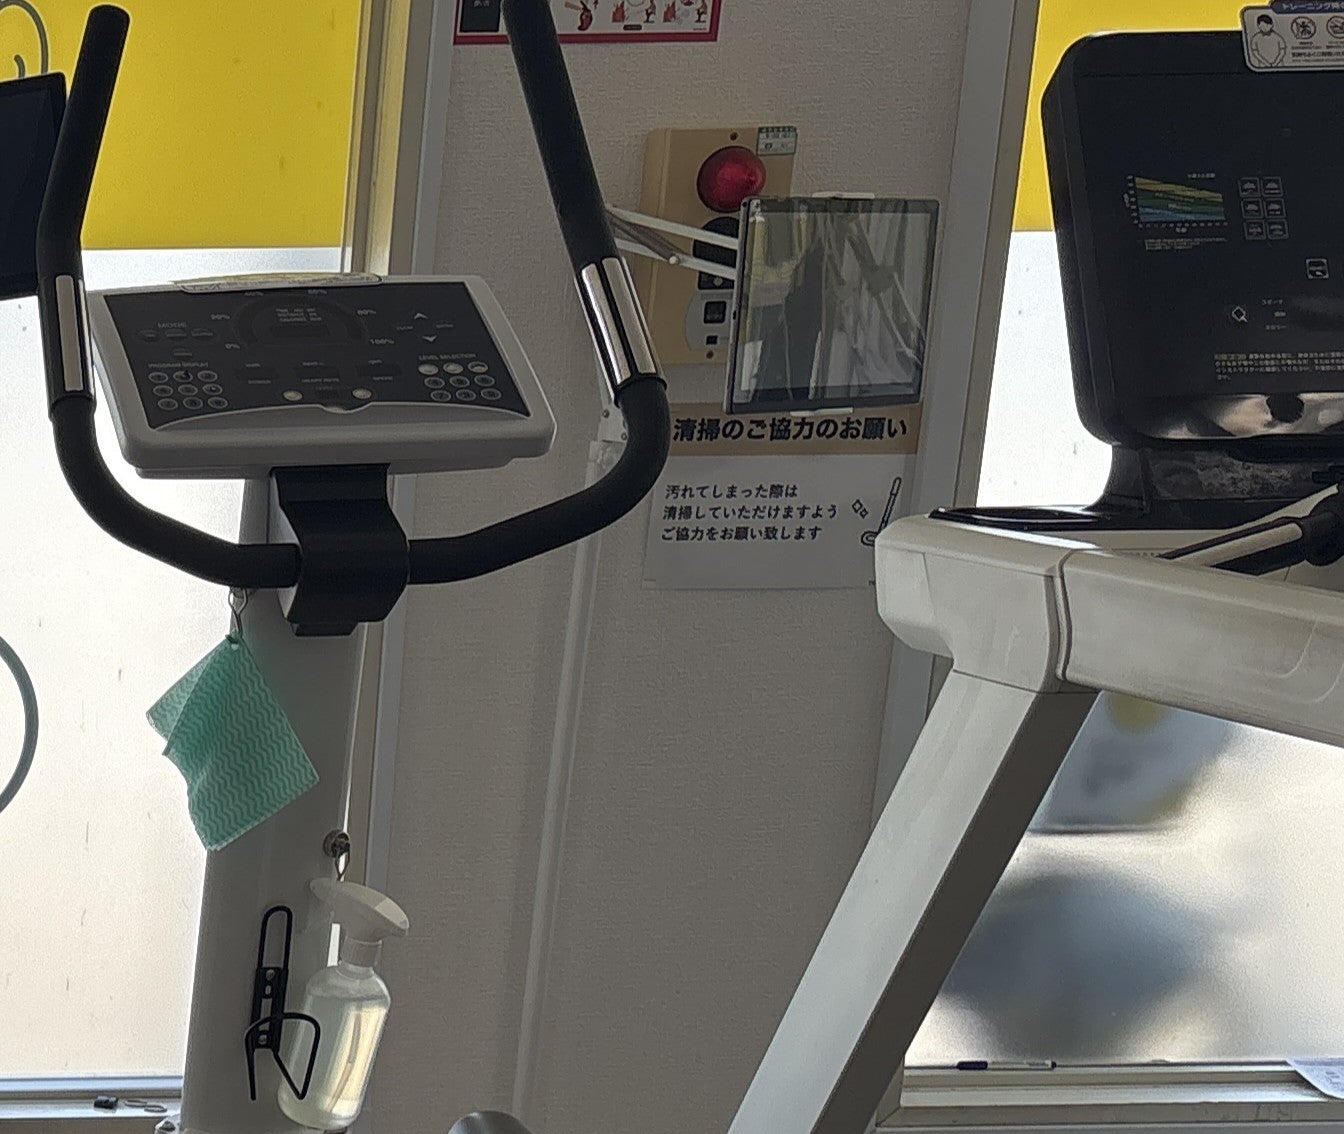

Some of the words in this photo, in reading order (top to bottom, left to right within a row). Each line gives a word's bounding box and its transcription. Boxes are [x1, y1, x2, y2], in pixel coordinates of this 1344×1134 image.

[673, 417, 907, 442] 清掃のご協力のお願い
[665, 484, 799, 499] 汚れてしまった際は
[663, 504, 839, 520] 清掃していただけますよう
[661, 526, 822, 541] ご協力をお願い致します
